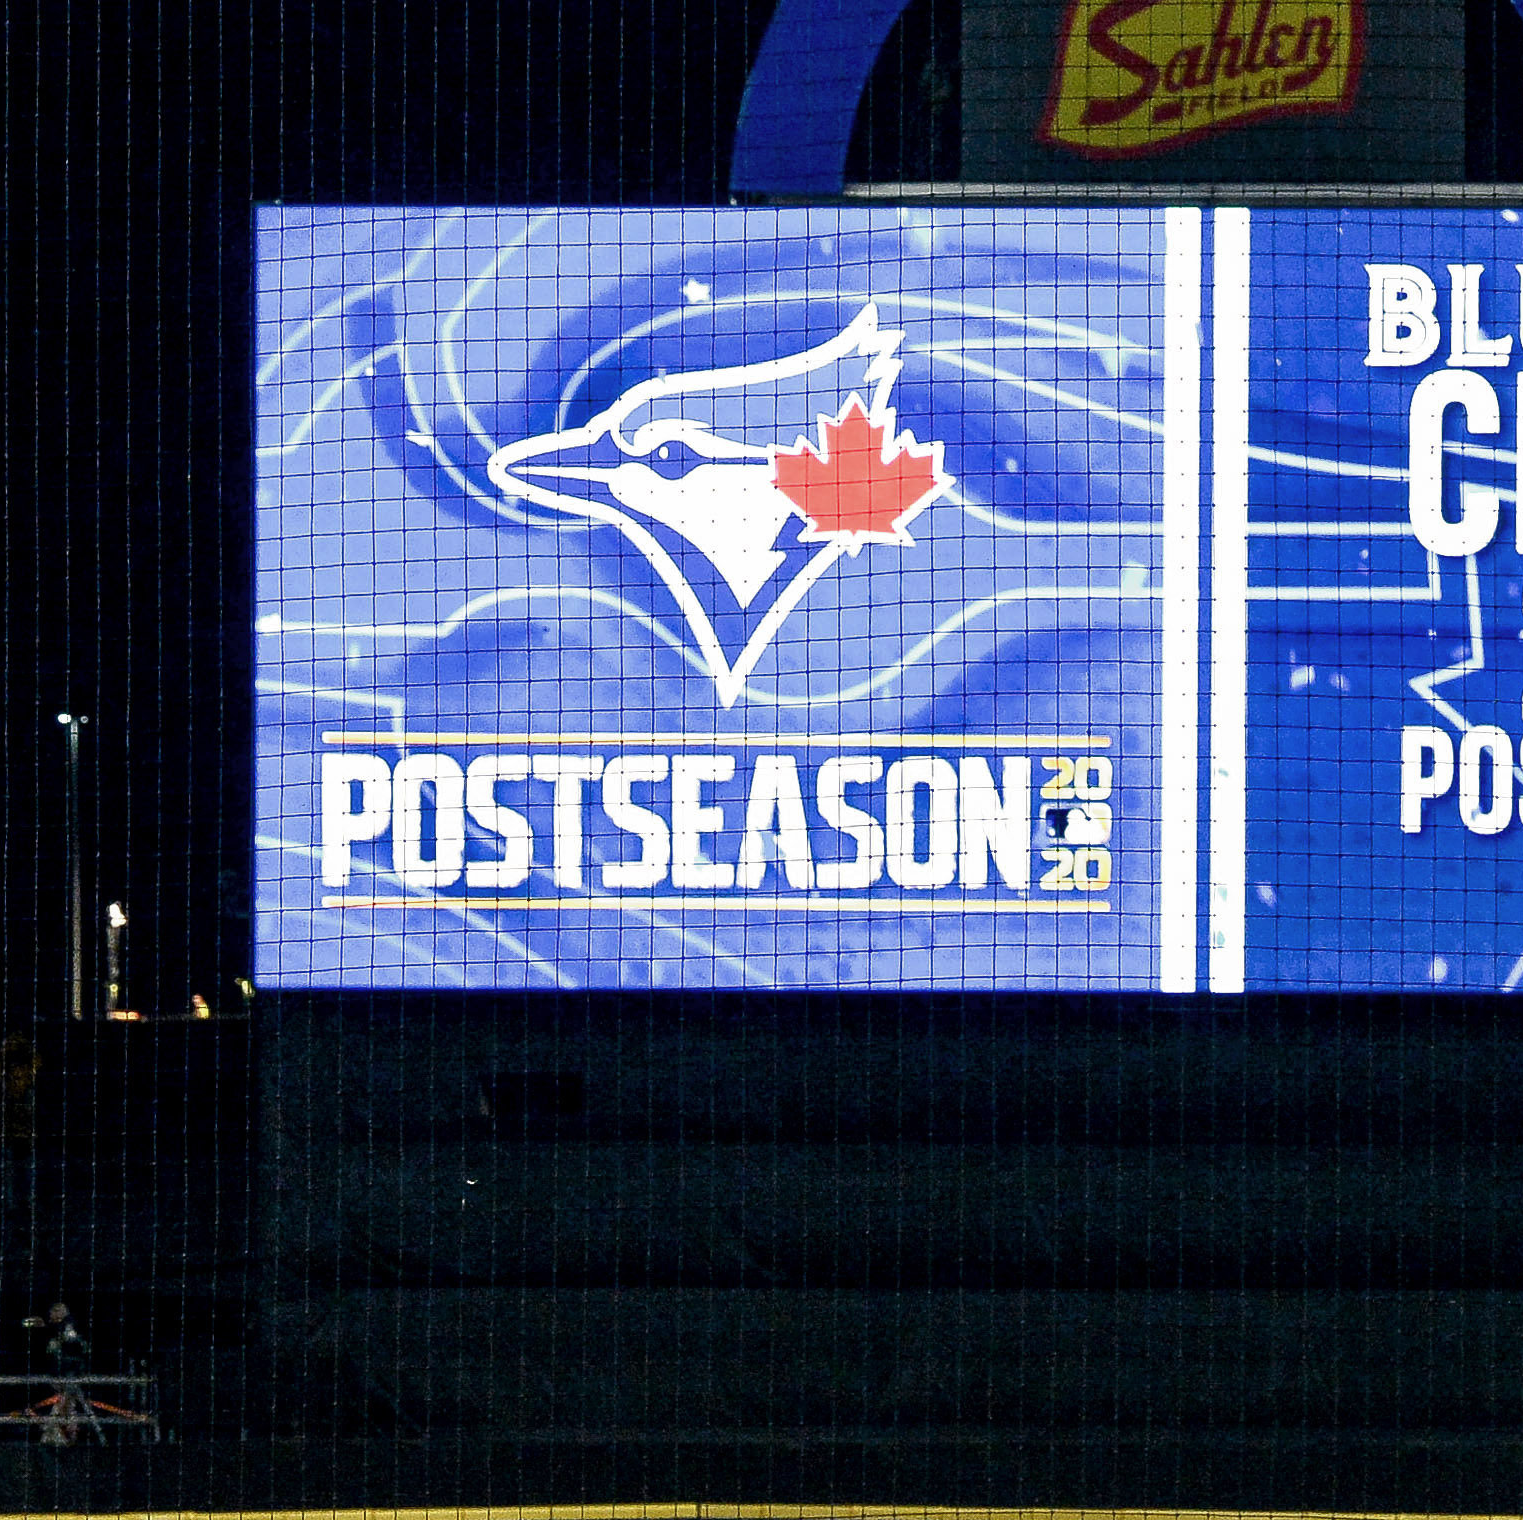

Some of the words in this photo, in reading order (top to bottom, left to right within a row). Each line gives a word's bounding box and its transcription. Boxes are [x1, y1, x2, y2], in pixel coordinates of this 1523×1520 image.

[1080, 0, 1334, 126] Sahlen
[1040, 757, 1112, 800] 20
[322, 753, 1030, 892] POSTSEASON
[1039, 847, 1112, 890] 20
